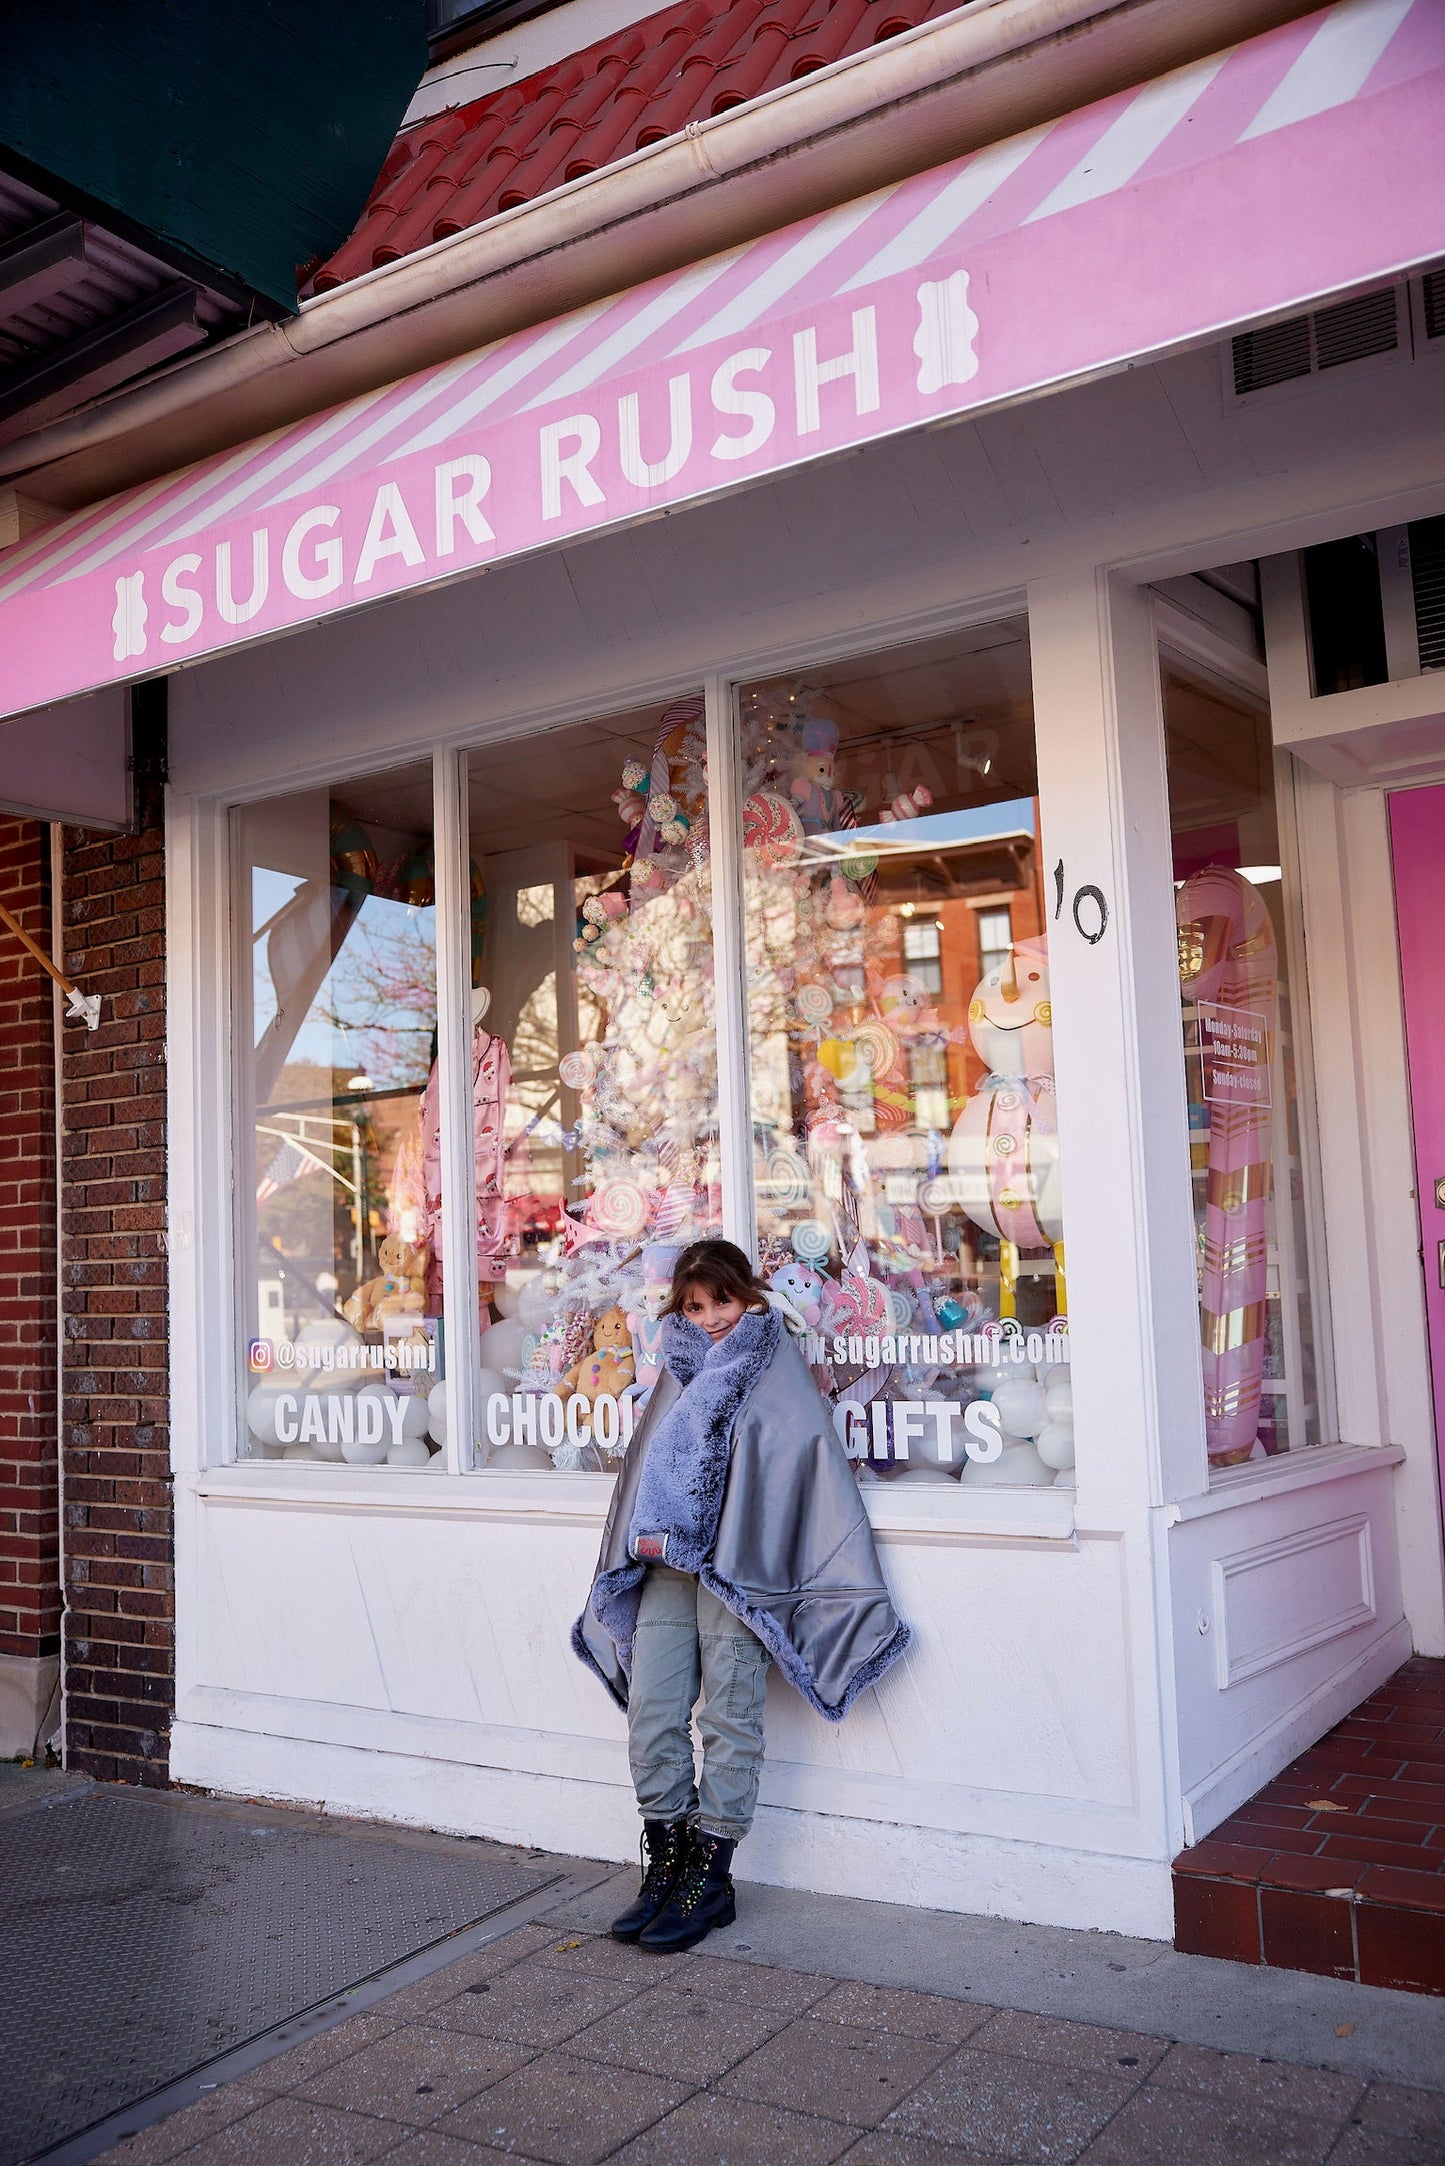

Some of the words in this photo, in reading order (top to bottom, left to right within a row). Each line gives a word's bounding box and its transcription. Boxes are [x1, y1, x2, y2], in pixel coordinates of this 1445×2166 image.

[159, 453, 497, 644] SUGAR
[539, 304, 881, 521] RUSH
[1053, 858, 1109, 945] 10
[1204, 1017, 1262, 1044] Monday-Saturday
[1212, 1040, 1258, 1062] 10am-5:30pm
[1212, 1068, 1262, 1091] Sunday-closed
[275, 1340, 437, 1373] @sugarrushnj
[642, 1350, 657, 1366] N
[274, 1393, 411, 1446] CANDY
[832, 1400, 1003, 1464] GIFTS
